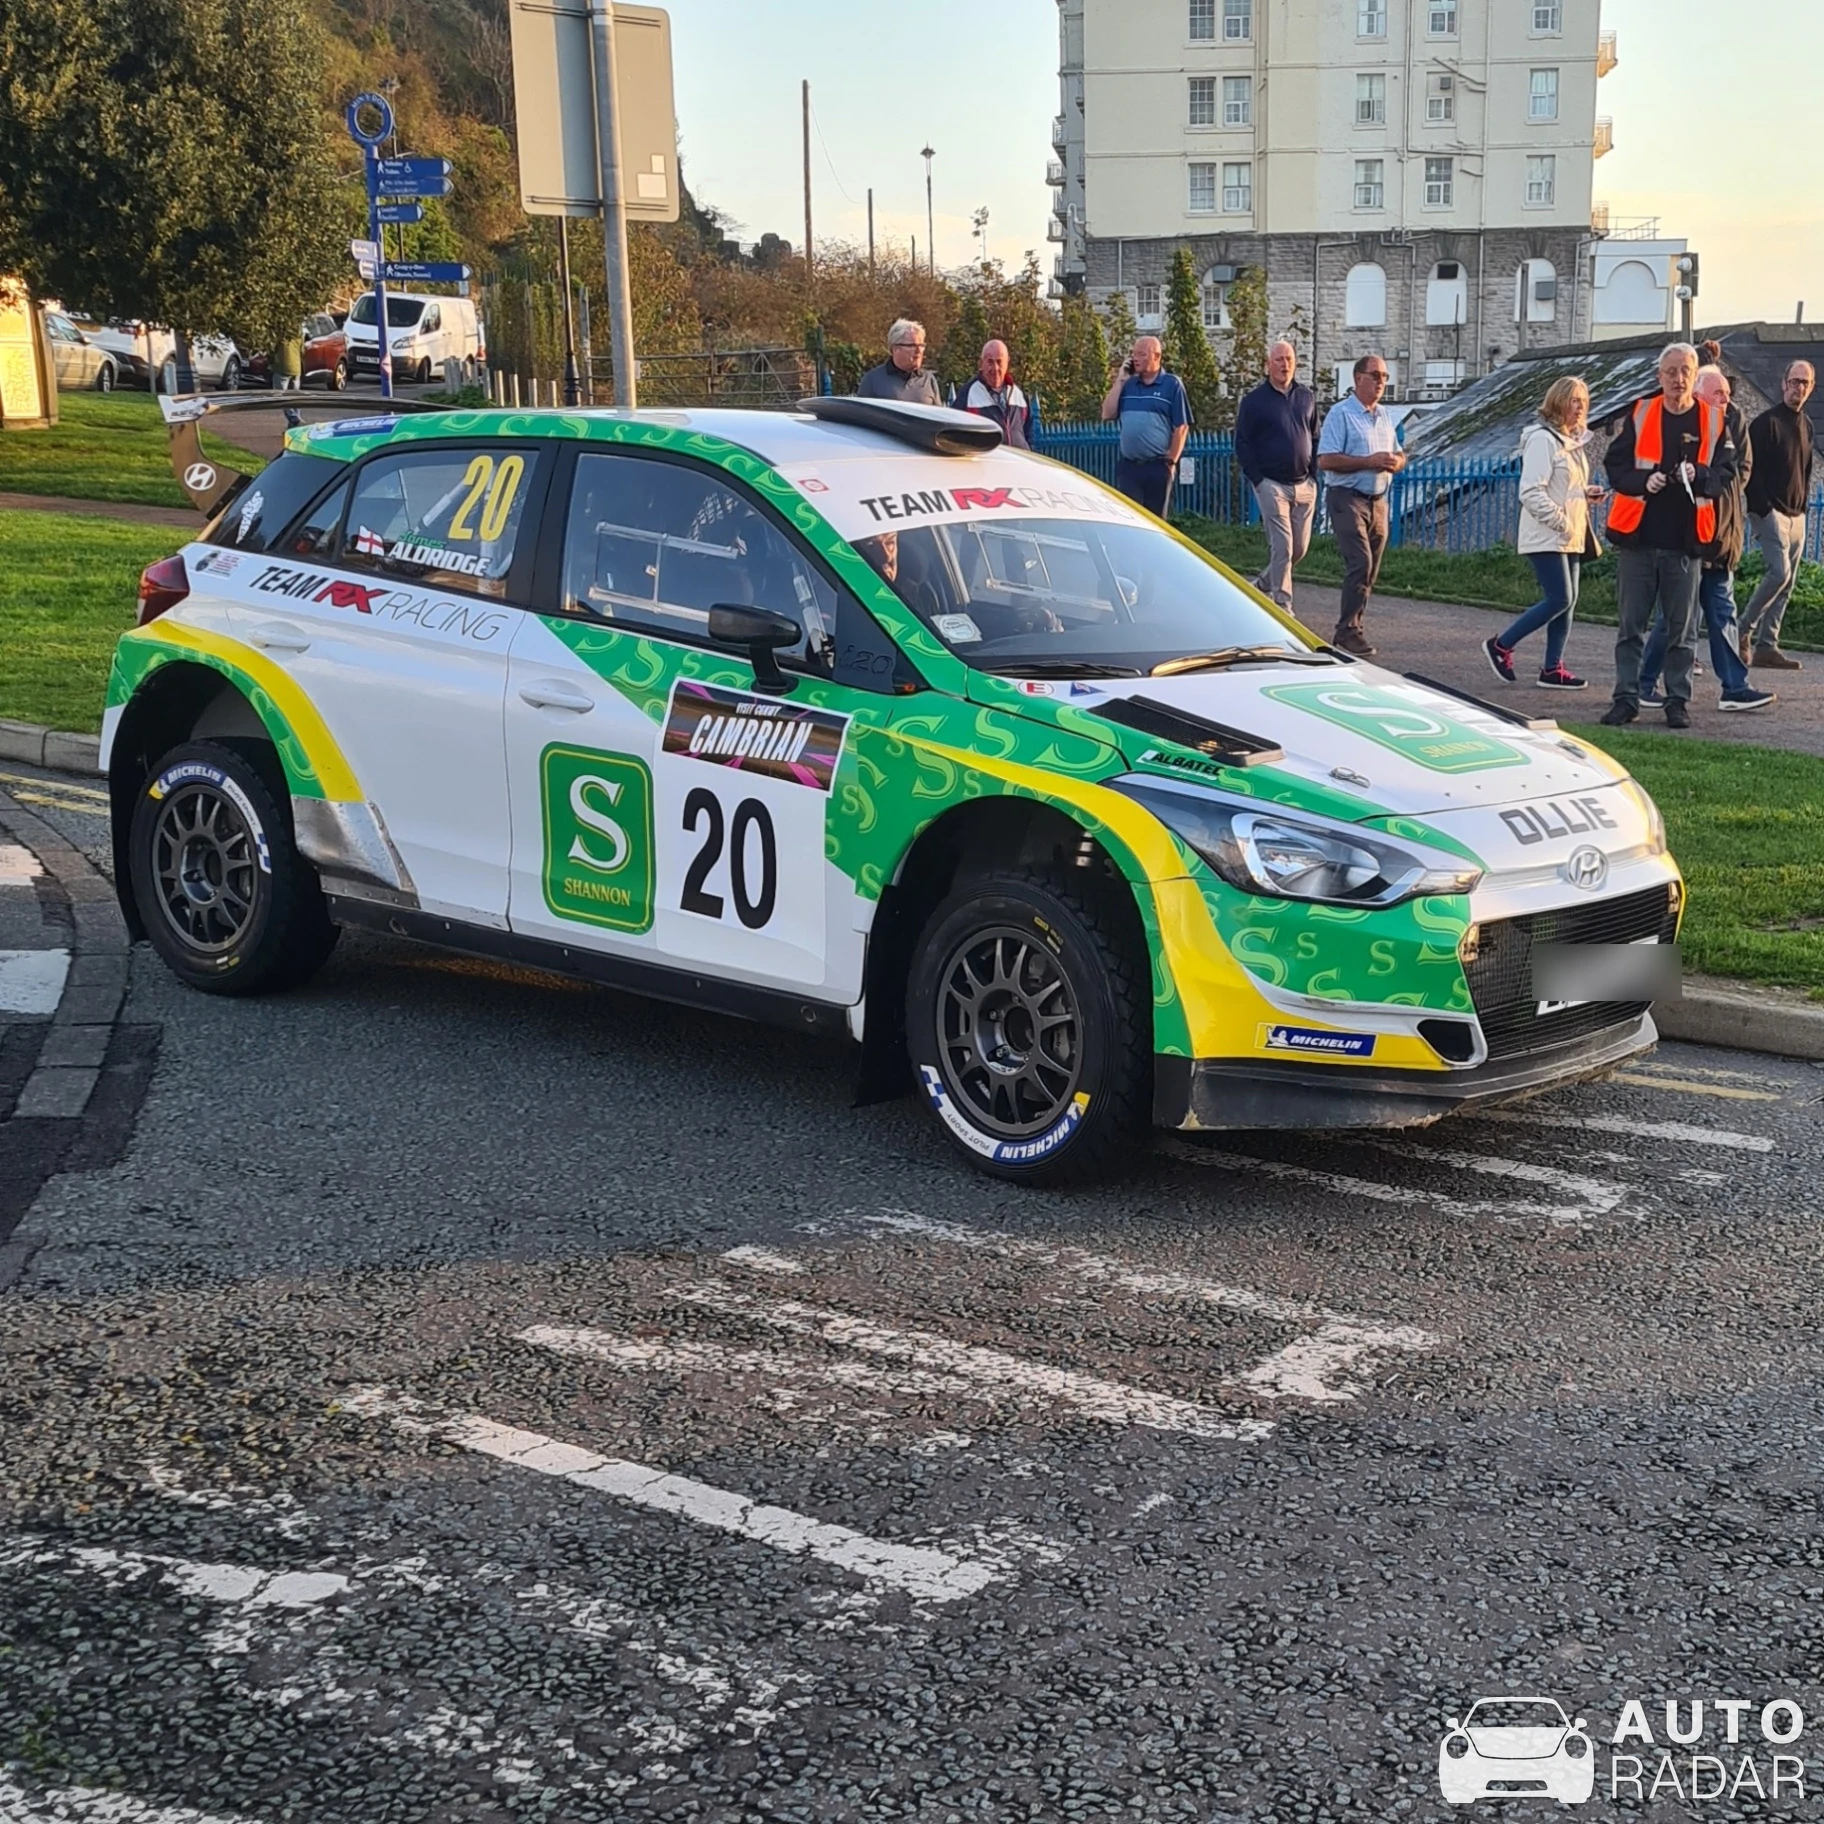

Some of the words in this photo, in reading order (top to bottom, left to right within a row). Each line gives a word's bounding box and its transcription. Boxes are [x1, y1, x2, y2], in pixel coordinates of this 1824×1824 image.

[448, 454, 525, 543] 20
[860, 488, 953, 521] TEAM
[948, 487, 1030, 510] RX
[399, 531, 446, 548] James
[388, 541, 491, 577] ALDRIDGE
[249, 565, 329, 600] TEAM
[312, 580, 392, 614] RX
[375, 592, 510, 641] RACING
[1316, 691, 1450, 740] S
[689, 714, 814, 763] CAMBRIAN
[1418, 739, 1496, 758] SHANNON
[167, 765, 222, 784] MICHELIN
[1151, 752, 1225, 776] ALBATEC
[567, 774, 631, 874] S
[1498, 797, 1619, 845] OLLIE
[680, 786, 777, 930] 20
[564, 877, 631, 907] SHANNON
[1290, 1034, 1362, 1050] MICHELIN
[947, 1113, 968, 1137] SPORT
[1000, 1118, 1070, 1159] MICHELIN
[969, 1135, 990, 1151] PILOT
